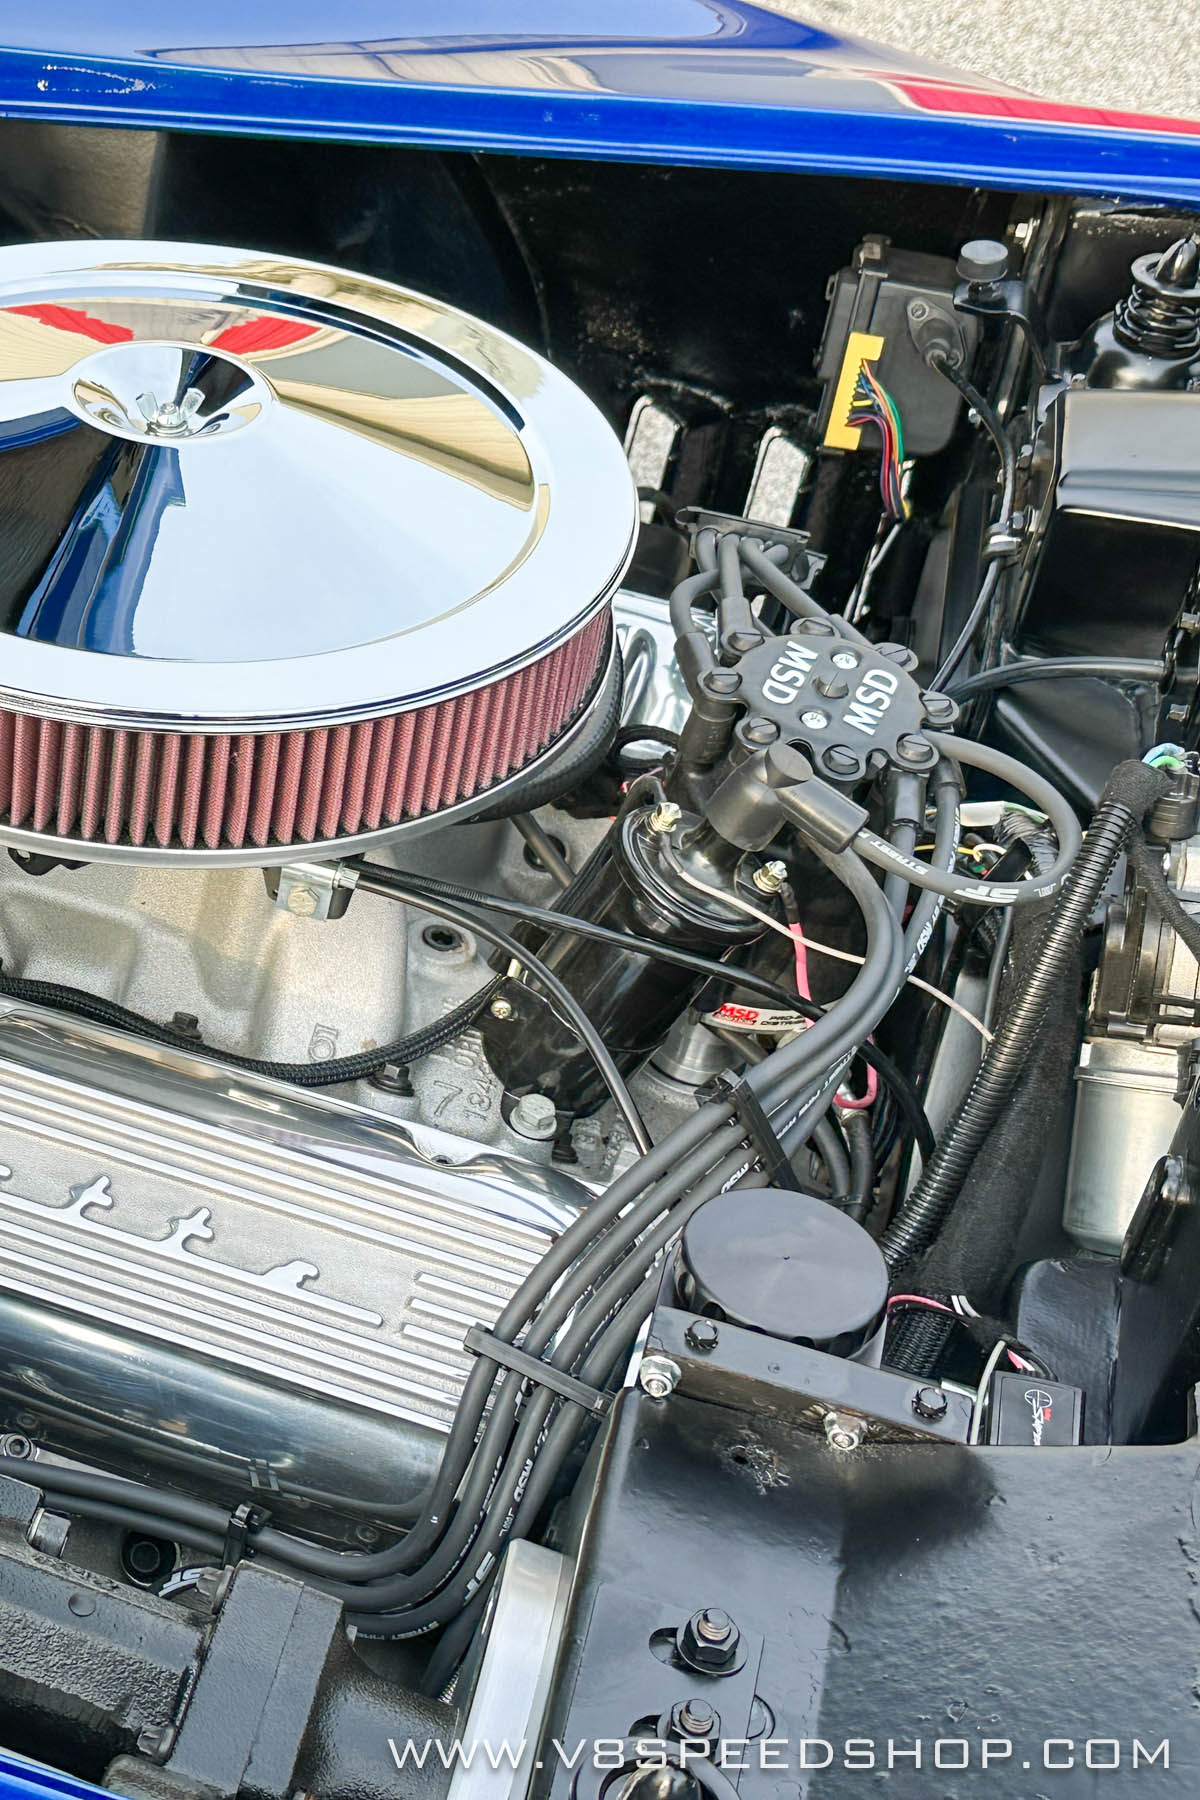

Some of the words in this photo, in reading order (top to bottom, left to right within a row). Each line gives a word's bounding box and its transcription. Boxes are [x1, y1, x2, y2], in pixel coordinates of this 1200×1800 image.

[761, 640, 819, 705] MSD
[842, 668, 899, 736] MSD
[720, 1005, 759, 1019] MSD
[308, 1022, 339, 1063] 5
[433, 1079, 464, 1118] 7
[513, 1458, 534, 1503] MSD
